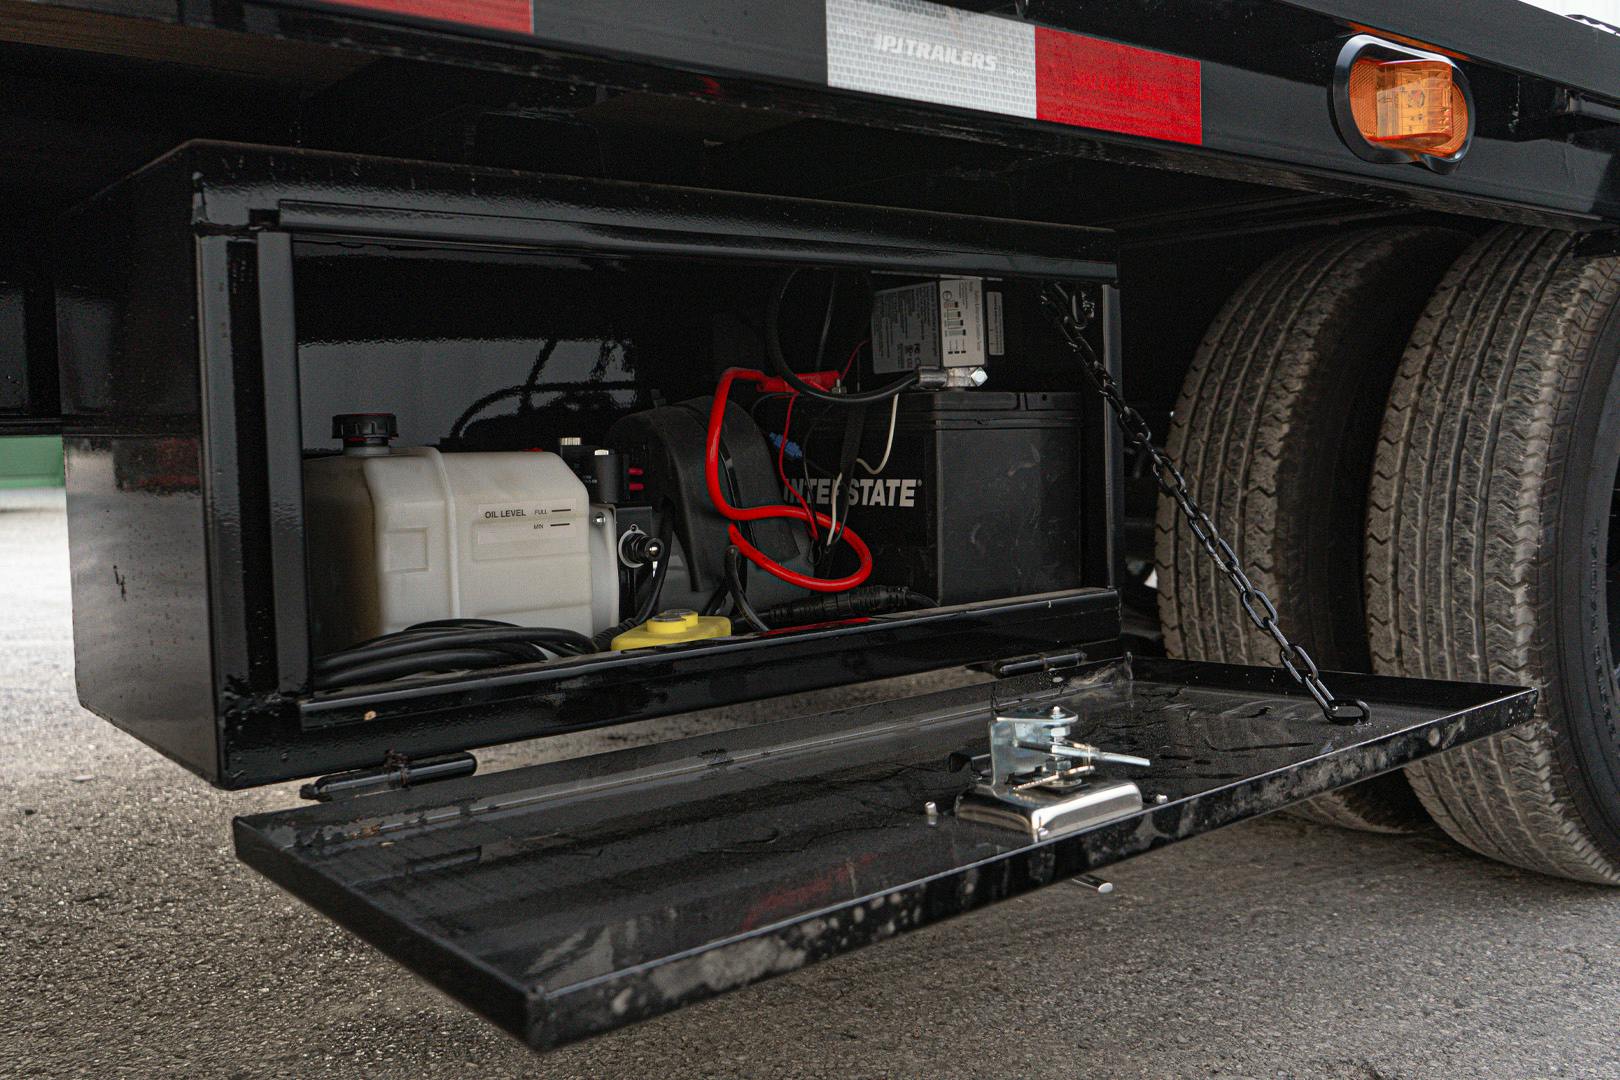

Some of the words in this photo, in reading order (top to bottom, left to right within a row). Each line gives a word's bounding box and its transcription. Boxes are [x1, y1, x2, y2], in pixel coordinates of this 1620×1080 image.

[904, 39, 998, 72] TRAILERS
[484, 511, 499, 519] OIL
[500, 509, 527, 518] LEVEL
